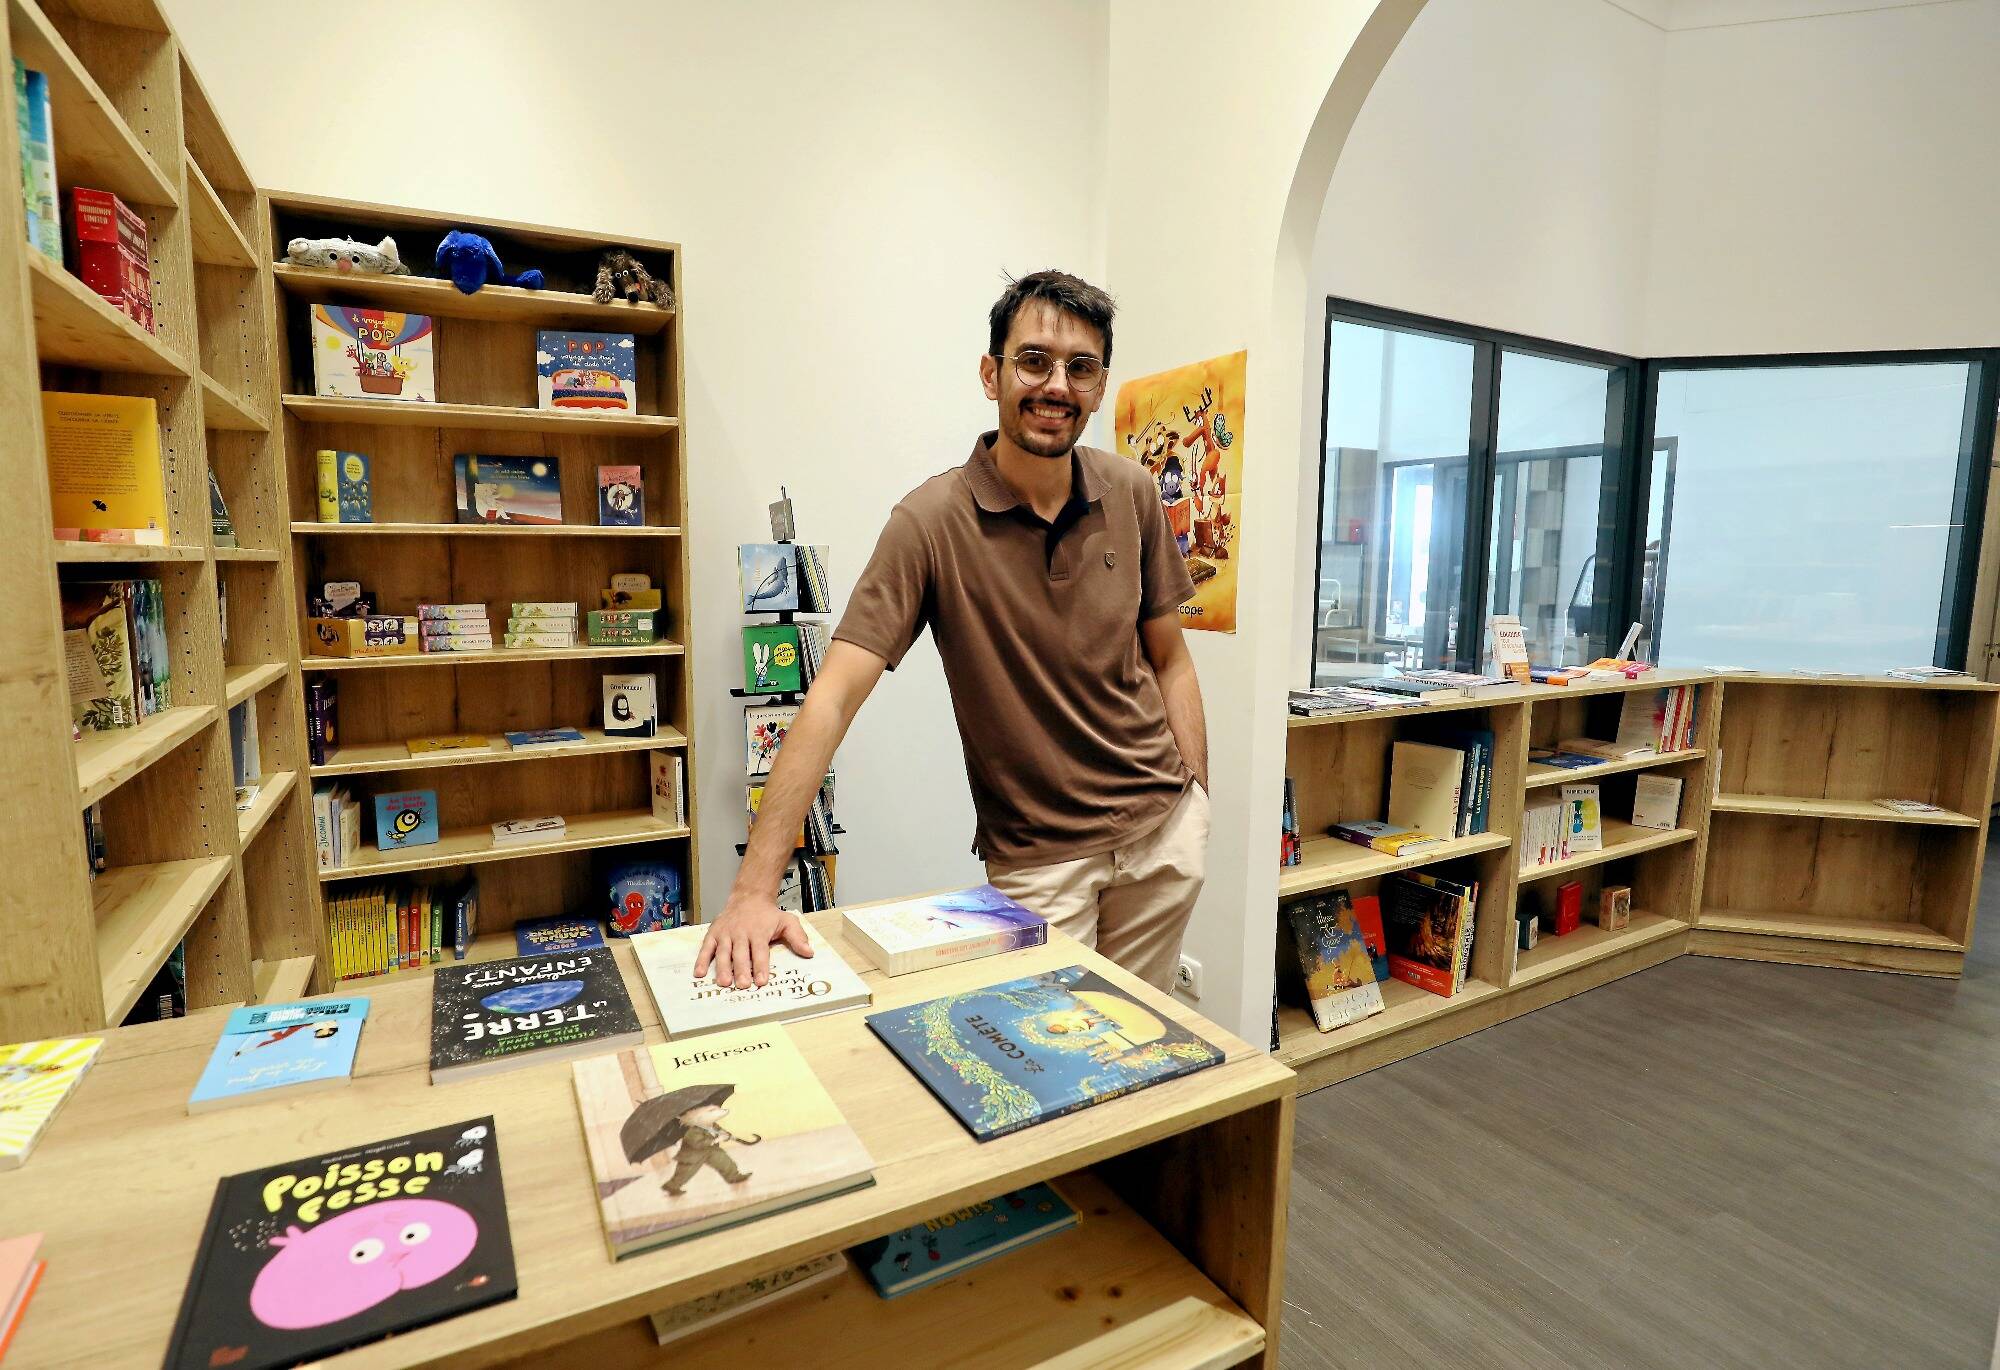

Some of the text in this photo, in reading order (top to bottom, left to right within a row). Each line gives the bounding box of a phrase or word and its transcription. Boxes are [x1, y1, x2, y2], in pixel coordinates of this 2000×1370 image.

[358, 326, 396, 342] POP
[567, 340, 606, 354] POP
[1177, 605, 1204, 619] cope
[462, 956, 592, 985] ENFANTS
[462, 1000, 608, 1041] LA TERRE
[964, 1014, 1025, 1060] COMÈTE
[672, 1040, 772, 1070] Jefferson
[262, 1150, 445, 1213] Poisson
